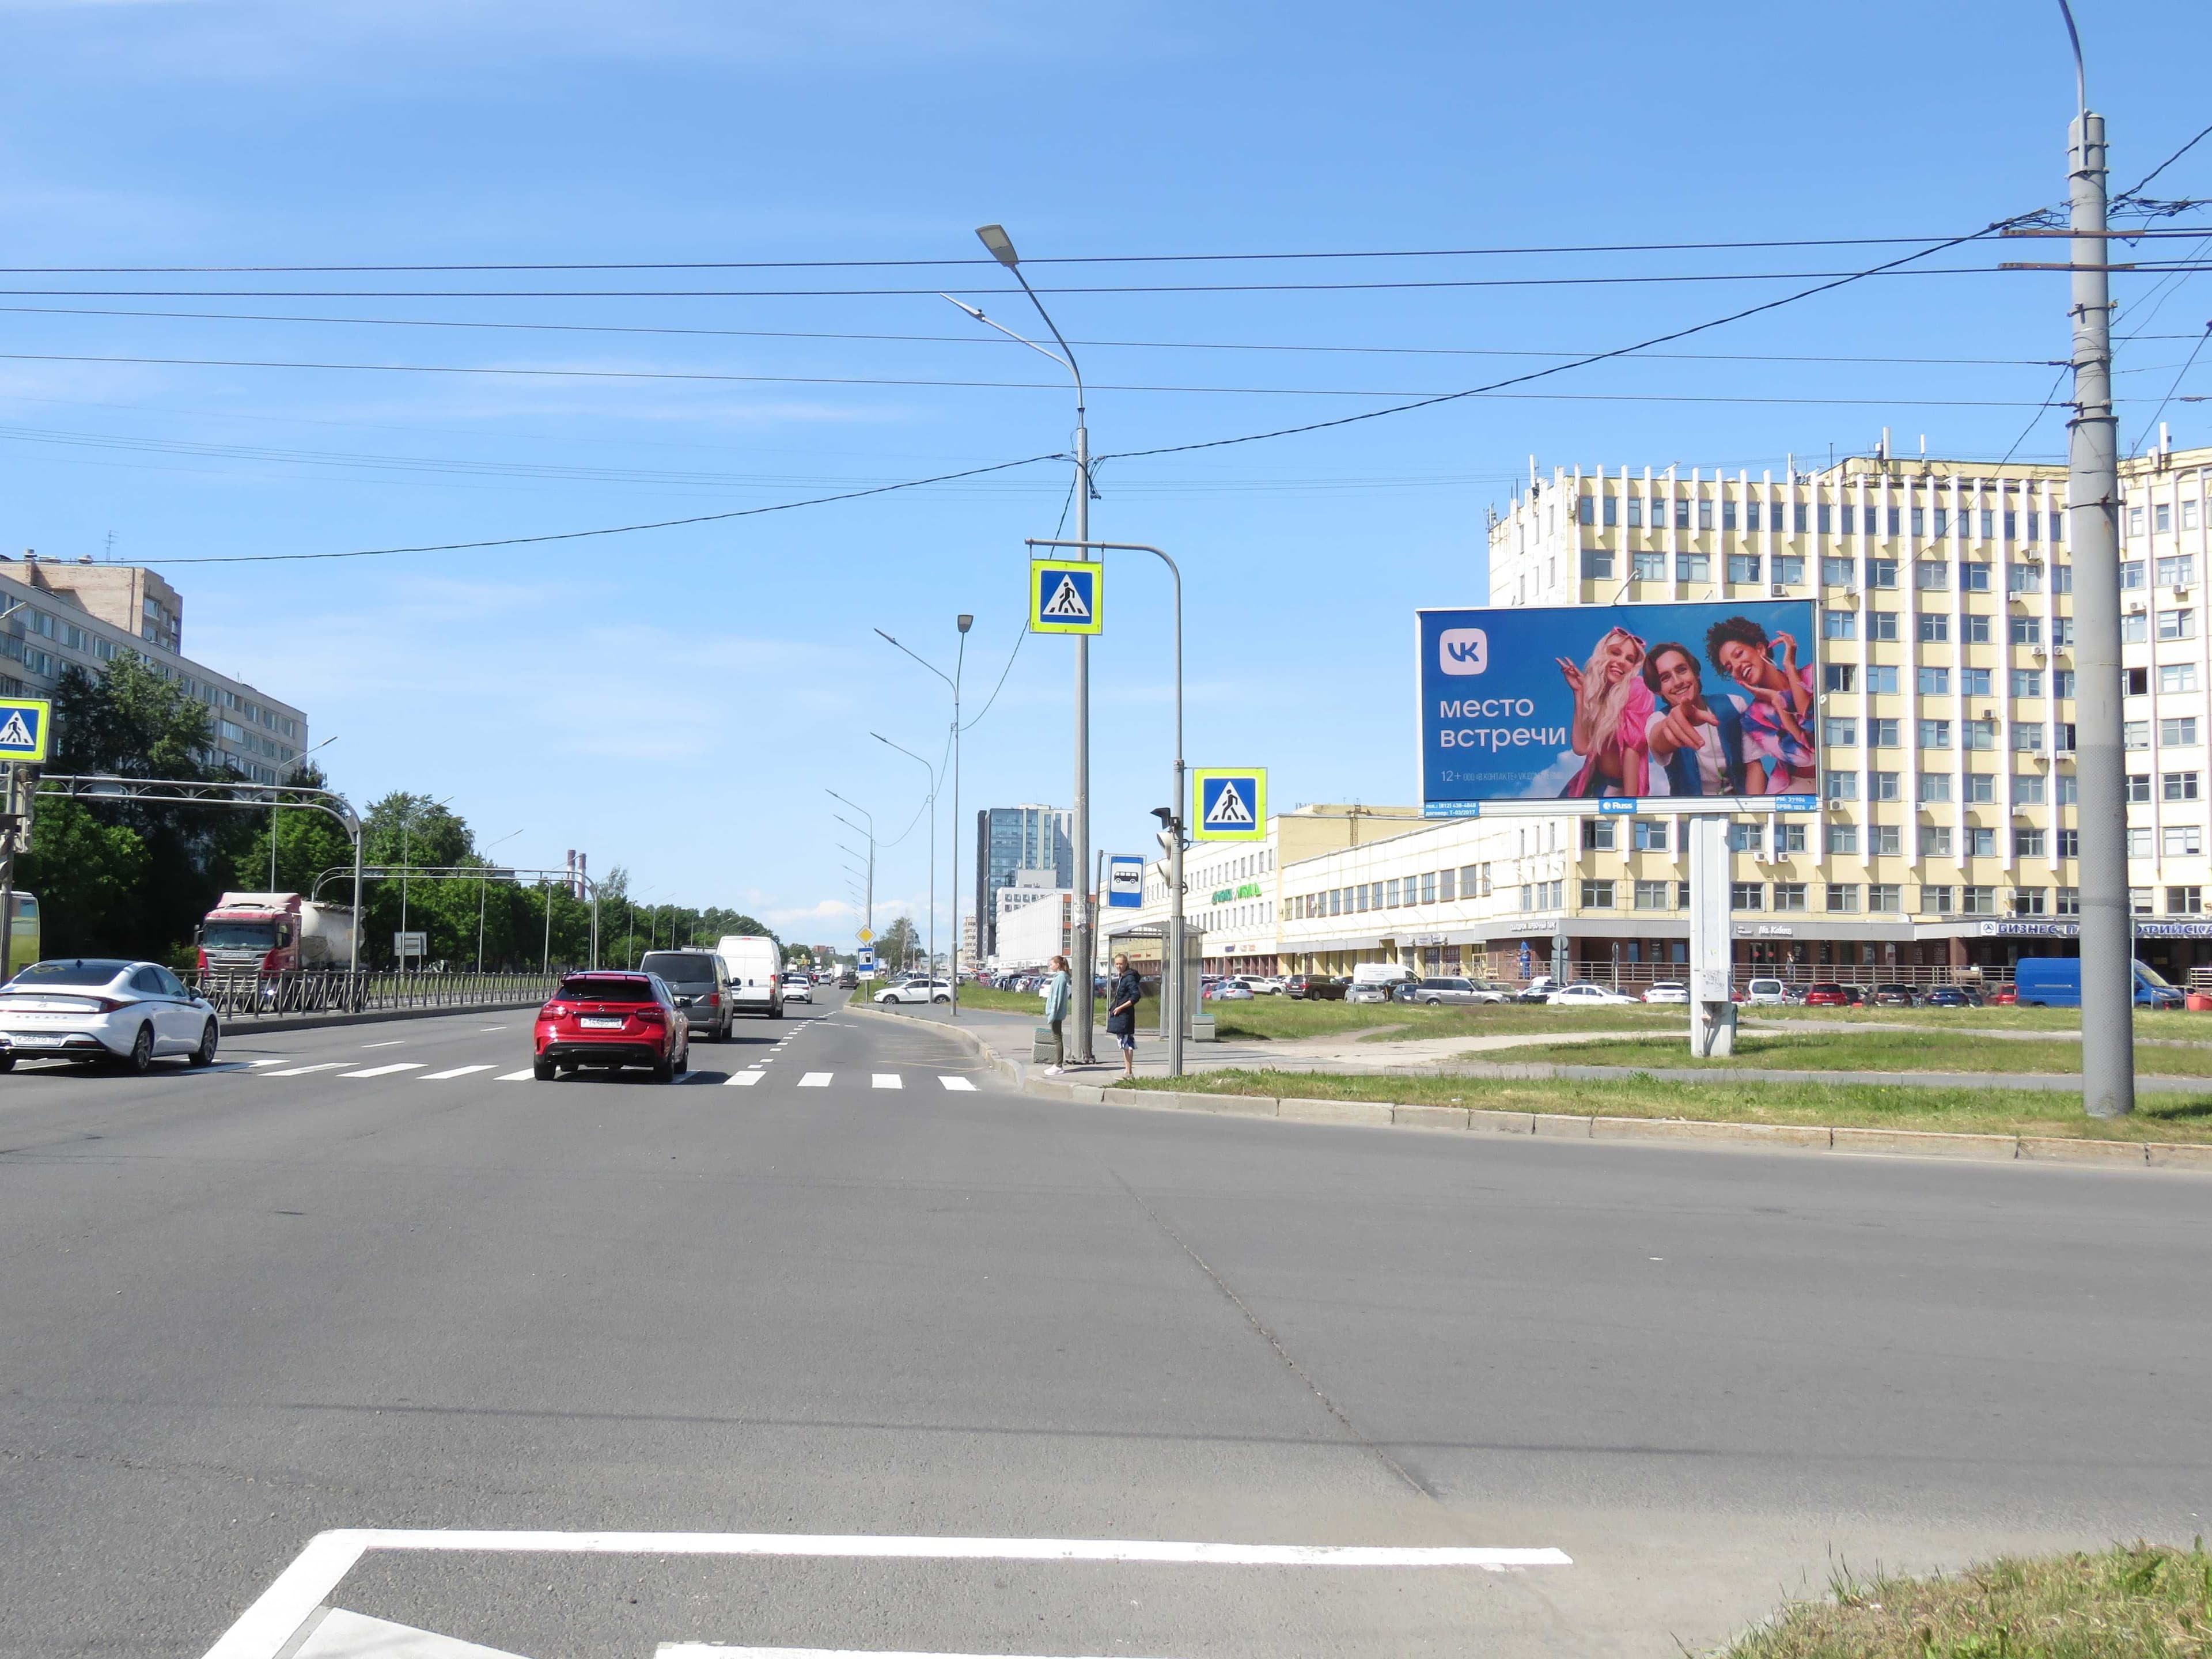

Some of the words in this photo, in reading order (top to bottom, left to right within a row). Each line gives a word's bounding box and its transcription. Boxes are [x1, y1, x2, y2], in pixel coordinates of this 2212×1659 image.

[1447, 642, 1479, 662] VK
[1440, 699, 1534, 718] место
[1441, 728, 1566, 753] встречи
[1441, 770, 1461, 782] 12+
